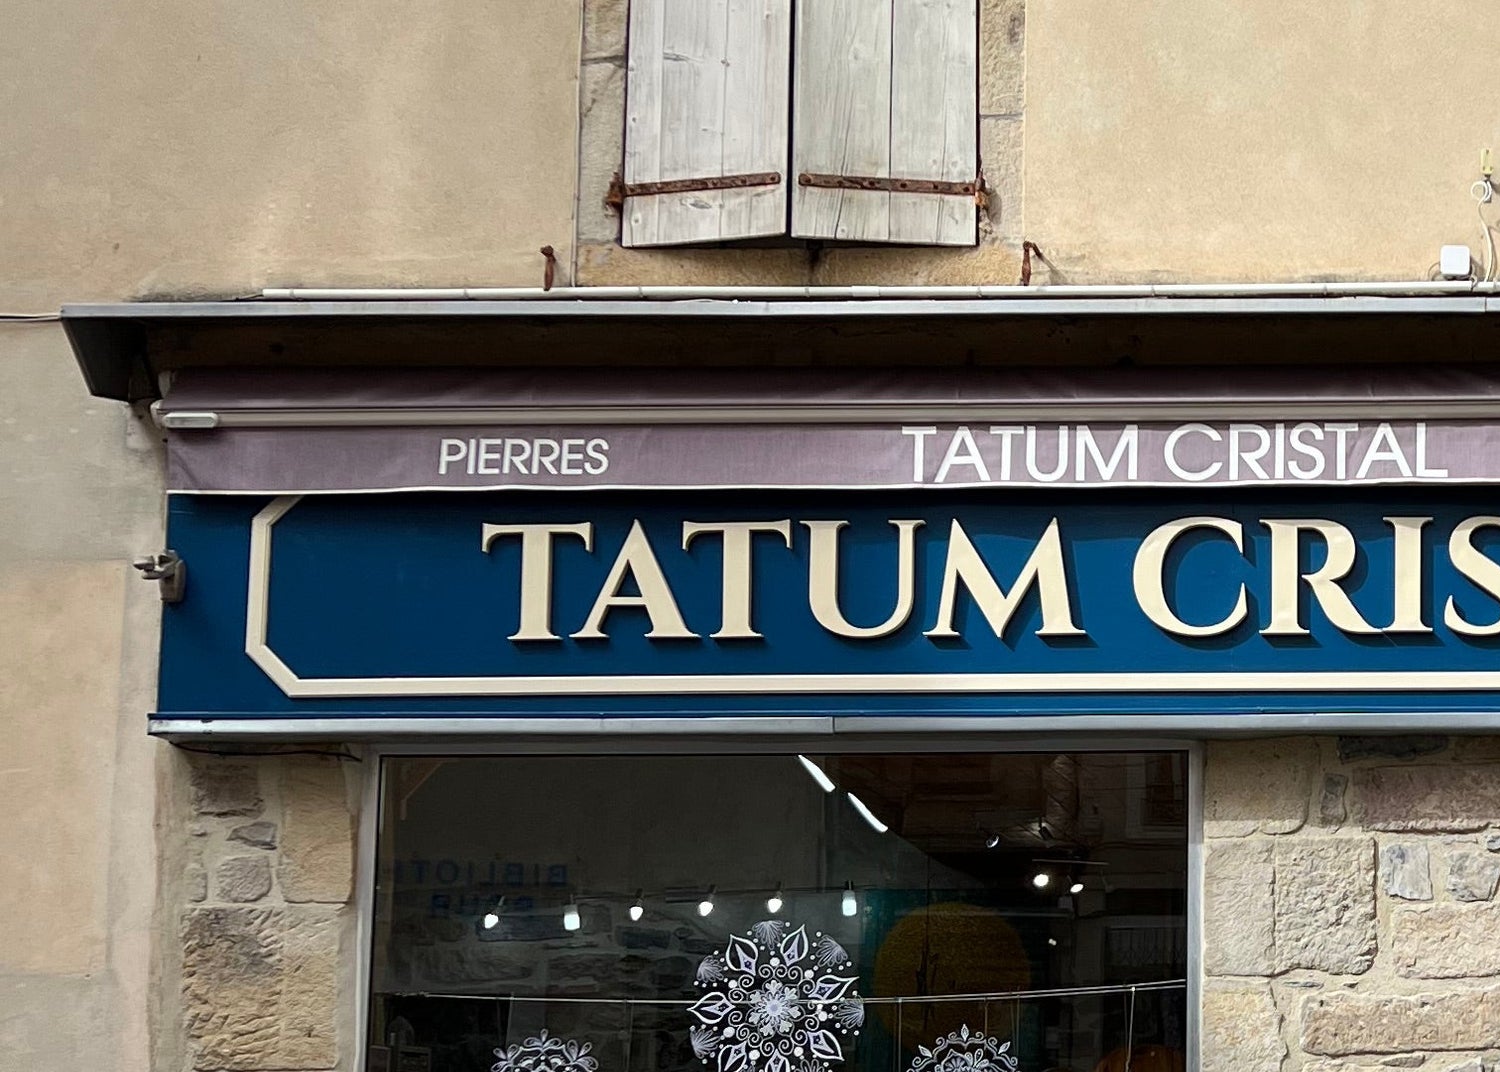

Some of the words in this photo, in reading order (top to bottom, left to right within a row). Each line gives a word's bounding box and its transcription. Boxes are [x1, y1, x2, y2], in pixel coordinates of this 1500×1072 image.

[438, 438, 609, 475] PIERRES
[901, 424, 1138, 484] TATUM
[1163, 422, 1449, 481] CRISTAL
[481, 516, 1087, 641] TATUM
